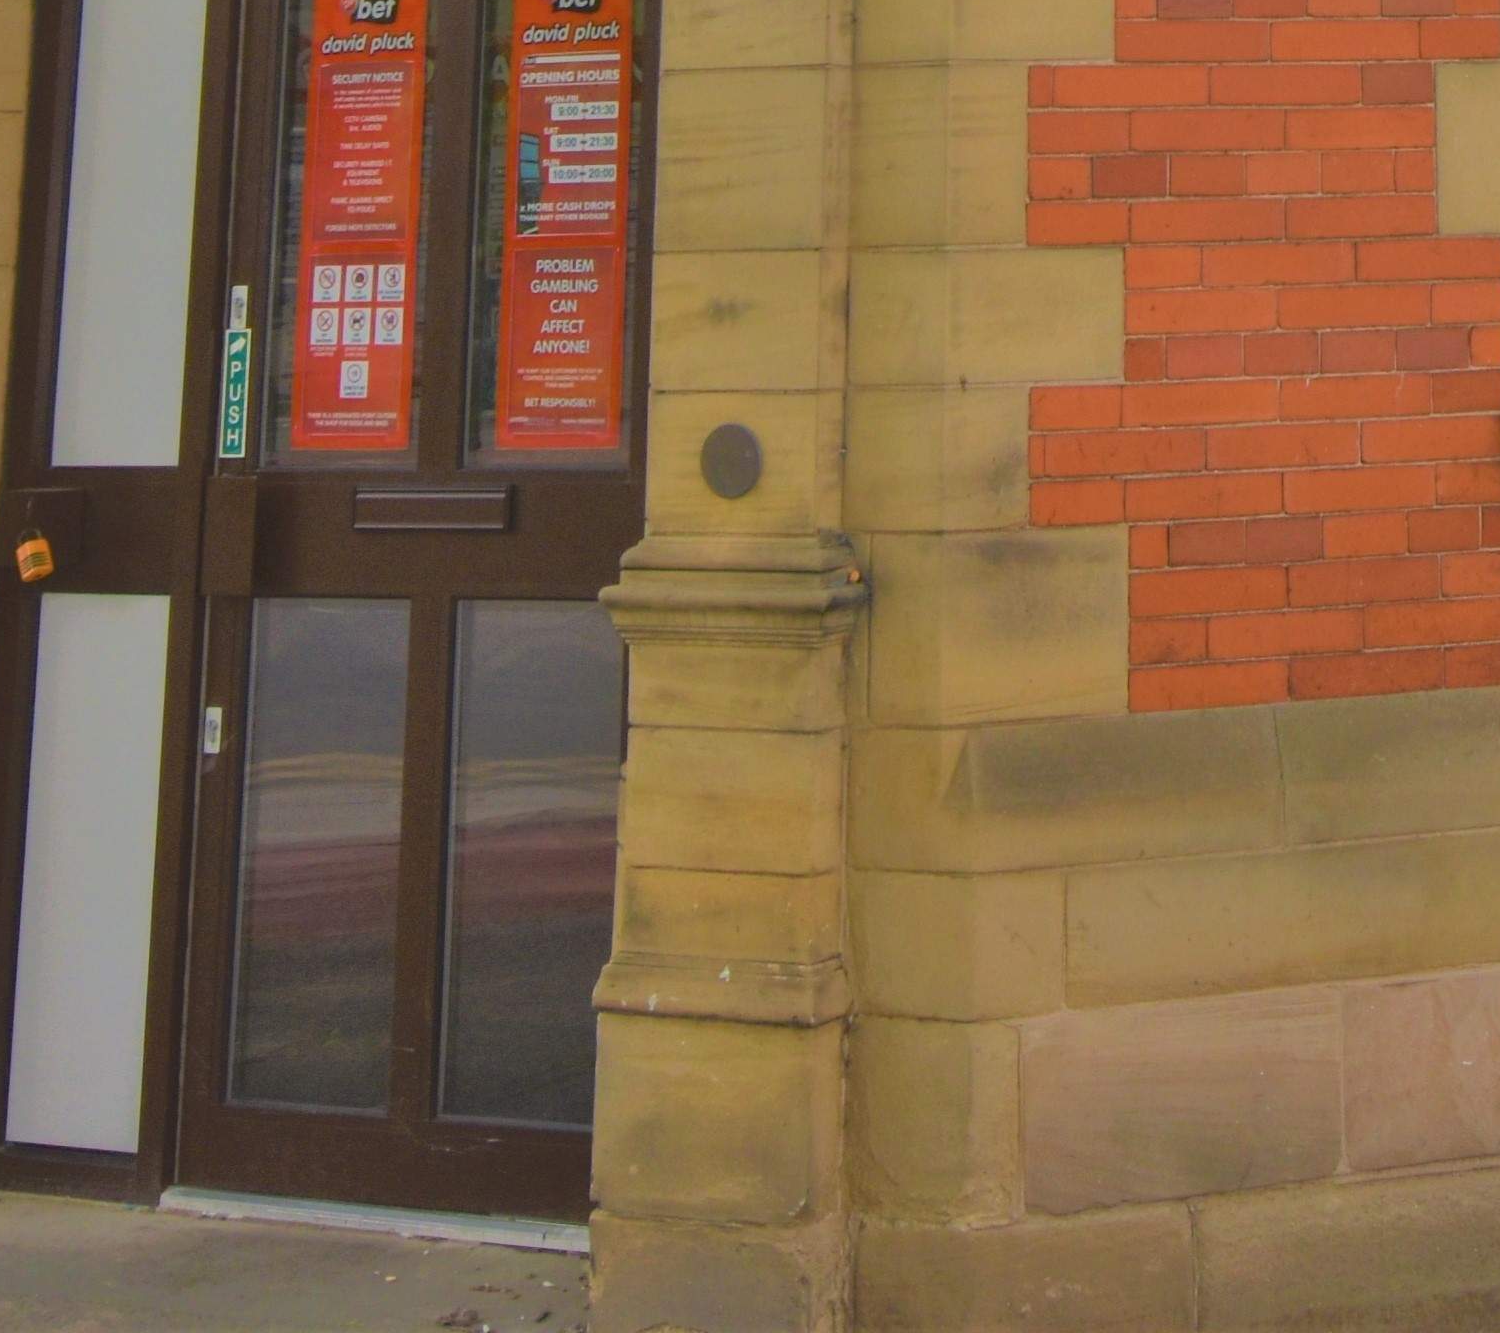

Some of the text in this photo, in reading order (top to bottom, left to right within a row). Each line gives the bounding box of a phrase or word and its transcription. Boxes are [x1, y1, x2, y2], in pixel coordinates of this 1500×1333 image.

[522, 20, 620, 45] david pluck
[321, 31, 415, 55] david pluck
[332, 71, 404, 85] SECURITY NOTICE
[521, 68, 620, 85] OPENING HOURS
[590, 104, 616, 116] 21:30
[589, 136, 615, 147] 21:30
[588, 167, 615, 179] 20:00
[526, 202, 554, 212] MORE
[555, 201, 582, 212] CASH
[583, 200, 616, 211] DROPS
[535, 258, 595, 273] PROBLEM
[530, 278, 599, 294] GAMBLING
[549, 299, 578, 313] CAN
[540, 319, 586, 334] AFFECT
[532, 339, 591, 354] ANYONE!
[226, 360, 242, 448] PUSH
[523, 397, 597, 408] BET RESPONSIBLY!
